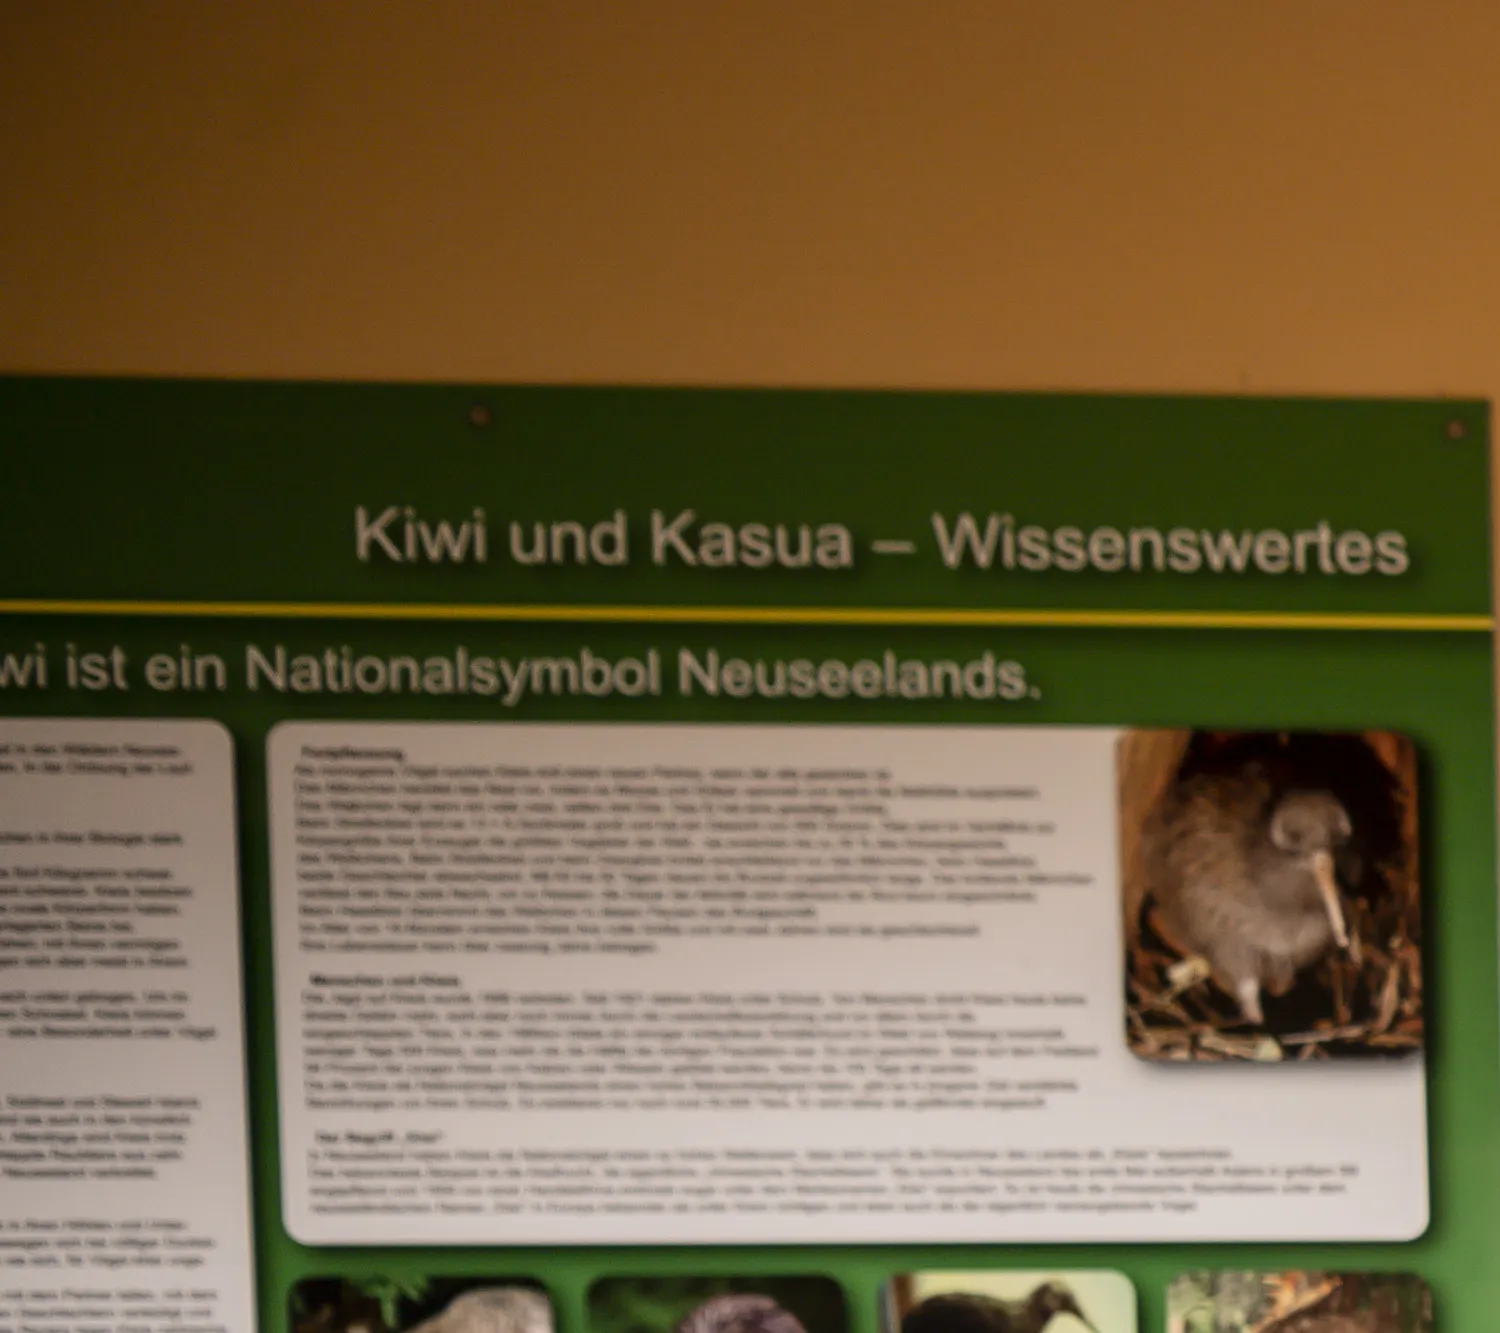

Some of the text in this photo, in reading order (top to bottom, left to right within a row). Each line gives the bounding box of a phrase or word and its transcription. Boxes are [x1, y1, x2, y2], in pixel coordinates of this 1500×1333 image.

[354, 506, 490, 562] Kiwi
[509, 510, 630, 566] und
[651, 511, 854, 569] Kasua
[931, 511, 1412, 575] Wissenswertes
[66, 643, 128, 690] ist
[144, 645, 227, 692] ein
[246, 645, 661, 706] Nationalsymbol
[679, 650, 1042, 701] Neuseelands.
